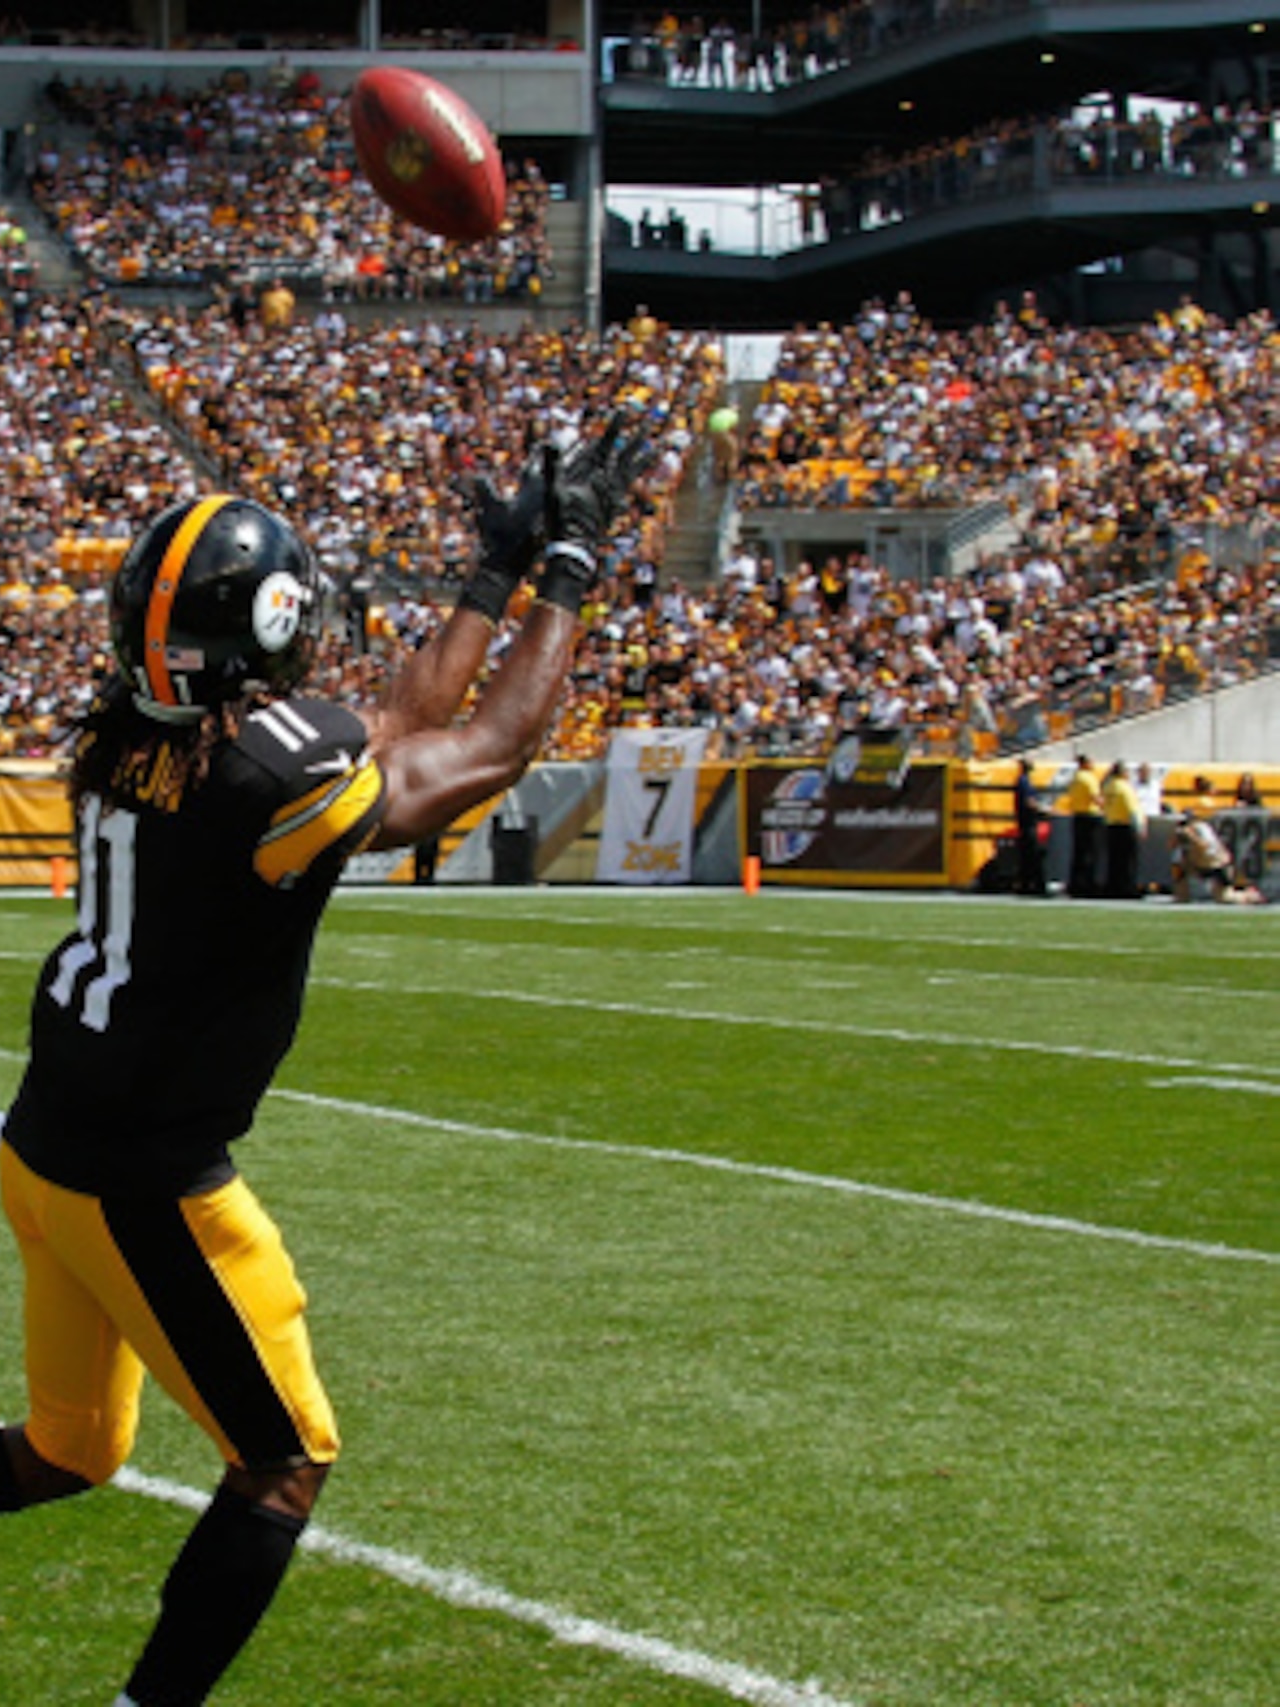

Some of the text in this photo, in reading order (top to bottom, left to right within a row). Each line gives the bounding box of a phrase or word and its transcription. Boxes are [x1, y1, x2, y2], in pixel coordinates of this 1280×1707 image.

[247, 699, 321, 752] 11
[644, 779, 672, 838] 7
[48, 790, 138, 1033] 11
